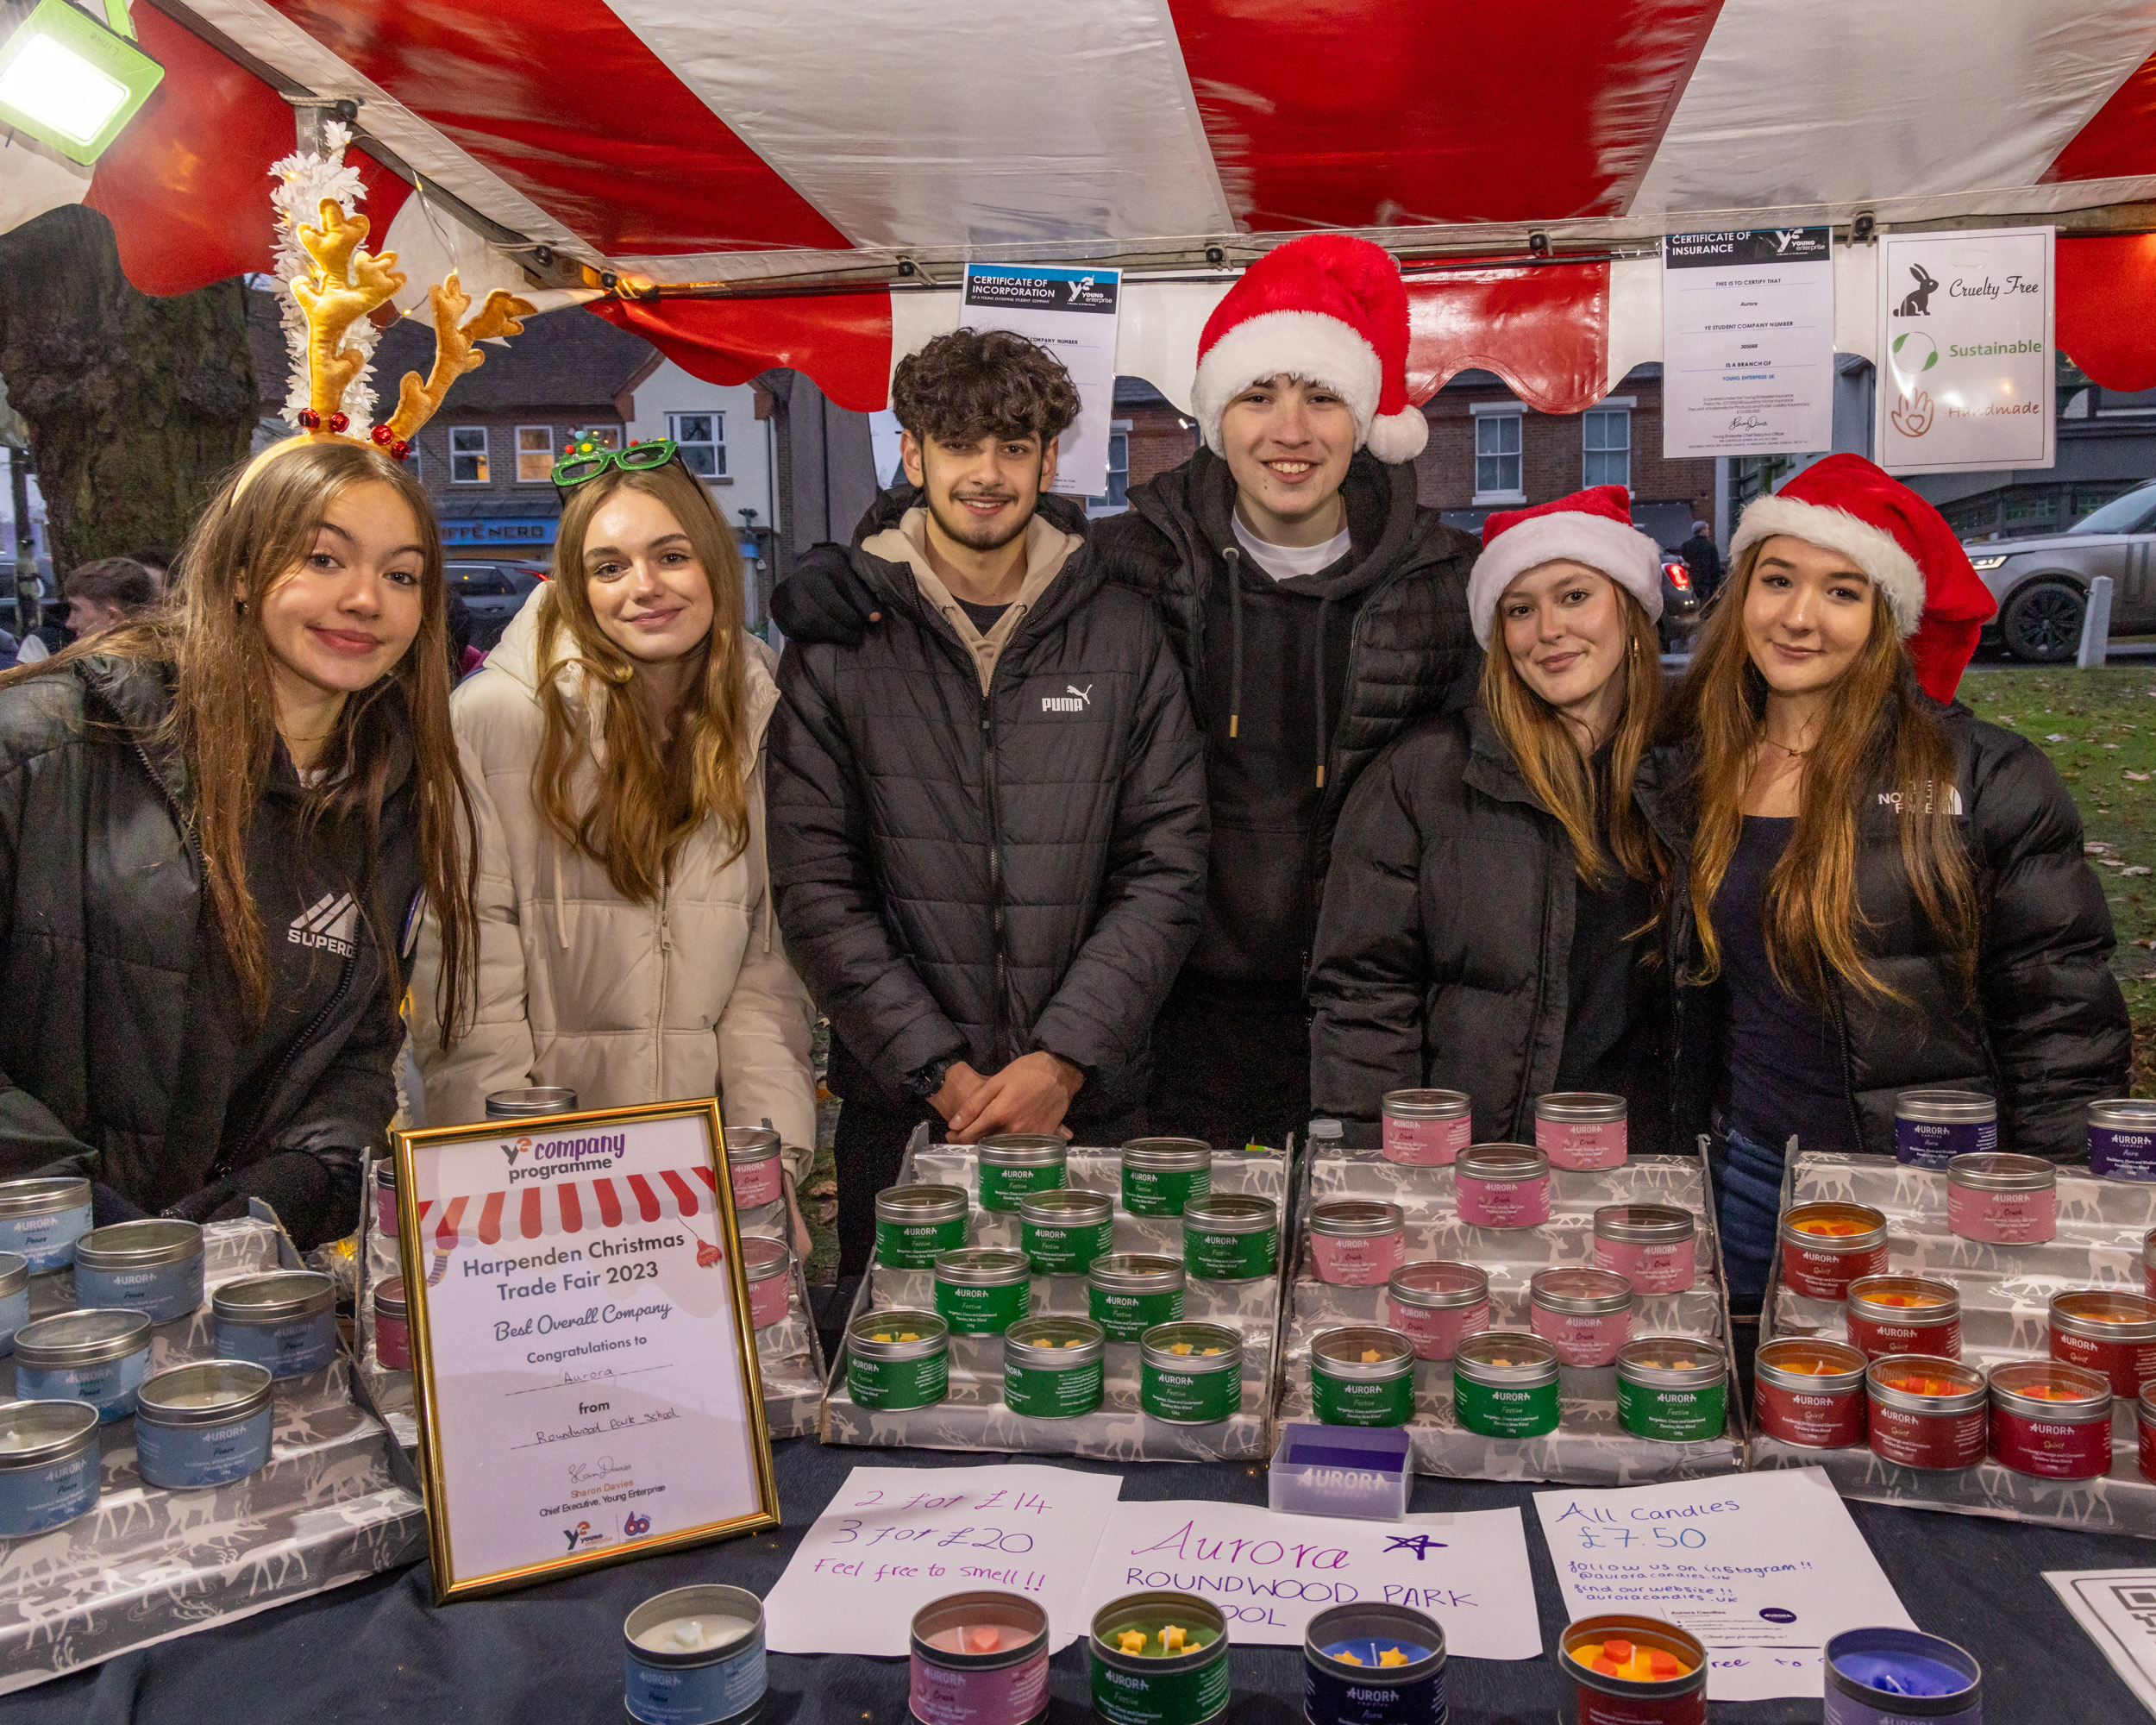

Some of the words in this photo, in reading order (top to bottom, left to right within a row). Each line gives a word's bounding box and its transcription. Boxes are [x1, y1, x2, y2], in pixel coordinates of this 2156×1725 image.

[1672, 231, 1735, 245] CERTIFICATE
[1736, 230, 1752, 241] OF
[1672, 243, 1733, 256] INSURANCE
[1796, 243, 1827, 252] enterprise
[973, 275, 1032, 286] CERTIFICATE
[1034, 279, 1048, 287] OF
[1949, 276, 2000, 299] Cruelty
[2003, 275, 2039, 295] Free
[972, 285, 1056, 298] INCORPORATION
[1949, 340, 2042, 357] Sustainable
[488, 525, 544, 539] NERO
[1042, 697, 1083, 712] PUMA
[1570, 1125, 1603, 1134] AURORA
[1914, 1125, 1950, 1135] AURORA
[2111, 1134, 2152, 1145] AURORA
[535, 1133, 626, 1162] company
[508, 1158, 612, 1184] programme
[734, 1163, 766, 1173] AURORA
[1001, 1170, 1034, 1179] AURORA
[1484, 1182, 1518, 1192] AURORA
[1992, 1194, 2030, 1203] AURORA
[14, 1216, 59, 1233] AURORA
[904, 1226, 937, 1237] AURORA
[1035, 1229, 1067, 1239] AURORA
[25, 1236, 47, 1245] Peace
[1204, 1235, 1238, 1245] AURORA
[1335, 1239, 1369, 1249] AURORA
[463, 1246, 583, 1278] Harpenden
[588, 1233, 685, 1261] Christmas
[1643, 1245, 1677, 1255] AURORA
[1802, 1251, 1839, 1263] AURORA
[113, 1272, 158, 1285] AURORA
[497, 1276, 557, 1301] Trade
[563, 1270, 601, 1289] Fair
[606, 1261, 659, 1285] 2023
[955, 1288, 989, 1298] AURORA
[1106, 1295, 1139, 1307] AURORA
[494, 1319, 533, 1342] Best
[537, 1307, 599, 1334] Overall
[602, 1300, 673, 1327] Company
[1565, 1317, 1602, 1327] AURORA
[1877, 1326, 1918, 1339] AURORA
[526, 1337, 631, 1364] Congratulations
[634, 1334, 647, 1346] to
[1889, 1342, 1908, 1352] Spirit
[2060, 1334, 2098, 1352] AURORA
[564, 1368, 613, 1385] Aurora
[1158, 1374, 1194, 1386] AURORA
[1344, 1384, 1382, 1394] AURORA
[1492, 1391, 1531, 1402] AURORA
[1656, 1393, 1697, 1403] AURORA
[1792, 1395, 1833, 1407] AURORA
[579, 1402, 610, 1414] from
[1804, 1410, 1825, 1421] Spirit
[1880, 1408, 1919, 1425] AURORA
[201, 1426, 247, 1443] AURORA
[536, 1421, 604, 1445] Roundwood
[610, 1416, 636, 1429] Park
[2029, 1422, 2075, 1435] AURORA
[2043, 1440, 2065, 1450] Spirit
[1296, 1467, 1390, 1492] AURORA
[571, 1485, 602, 1498] Sharon
[605, 1479, 634, 1492] Davies
[539, 1506, 561, 1517] Chief
[562, 1498, 601, 1512] Executive,
[602, 1491, 627, 1504] Young
[628, 1484, 666, 1498] Enterprise
[855, 1490, 885, 1507] 2
[901, 1493, 968, 1510] for
[975, 1490, 1053, 1515] £14
[1555, 1502, 1617, 1523] All
[624, 1510, 650, 1536] 60
[580, 1534, 603, 1543] YOUNG
[585, 1536, 613, 1546] enterprise
[831, 1519, 862, 1544] 3
[866, 1527, 941, 1546] for
[937, 1527, 1034, 1553] £20
[1577, 1526, 1707, 1550] £7.50
[1131, 1519, 1351, 1570] Aurora
[814, 1558, 864, 1578] Feel
[874, 1563, 919, 1583] free
[928, 1563, 945, 1578] to
[1568, 1561, 1639, 1573] follow
[1127, 1567, 1358, 1604] ROUNDWOOD
[1383, 1584, 1479, 1608] PARK
[1574, 1584, 1612, 1594] find
[1649, 1585, 1714, 1595] website
[1707, 1651, 1751, 1669] ree
[1775, 1658, 1802, 1669] to
[1105, 1670, 1150, 1691] AURORA
[1346, 1687, 1400, 1703] AURORA
